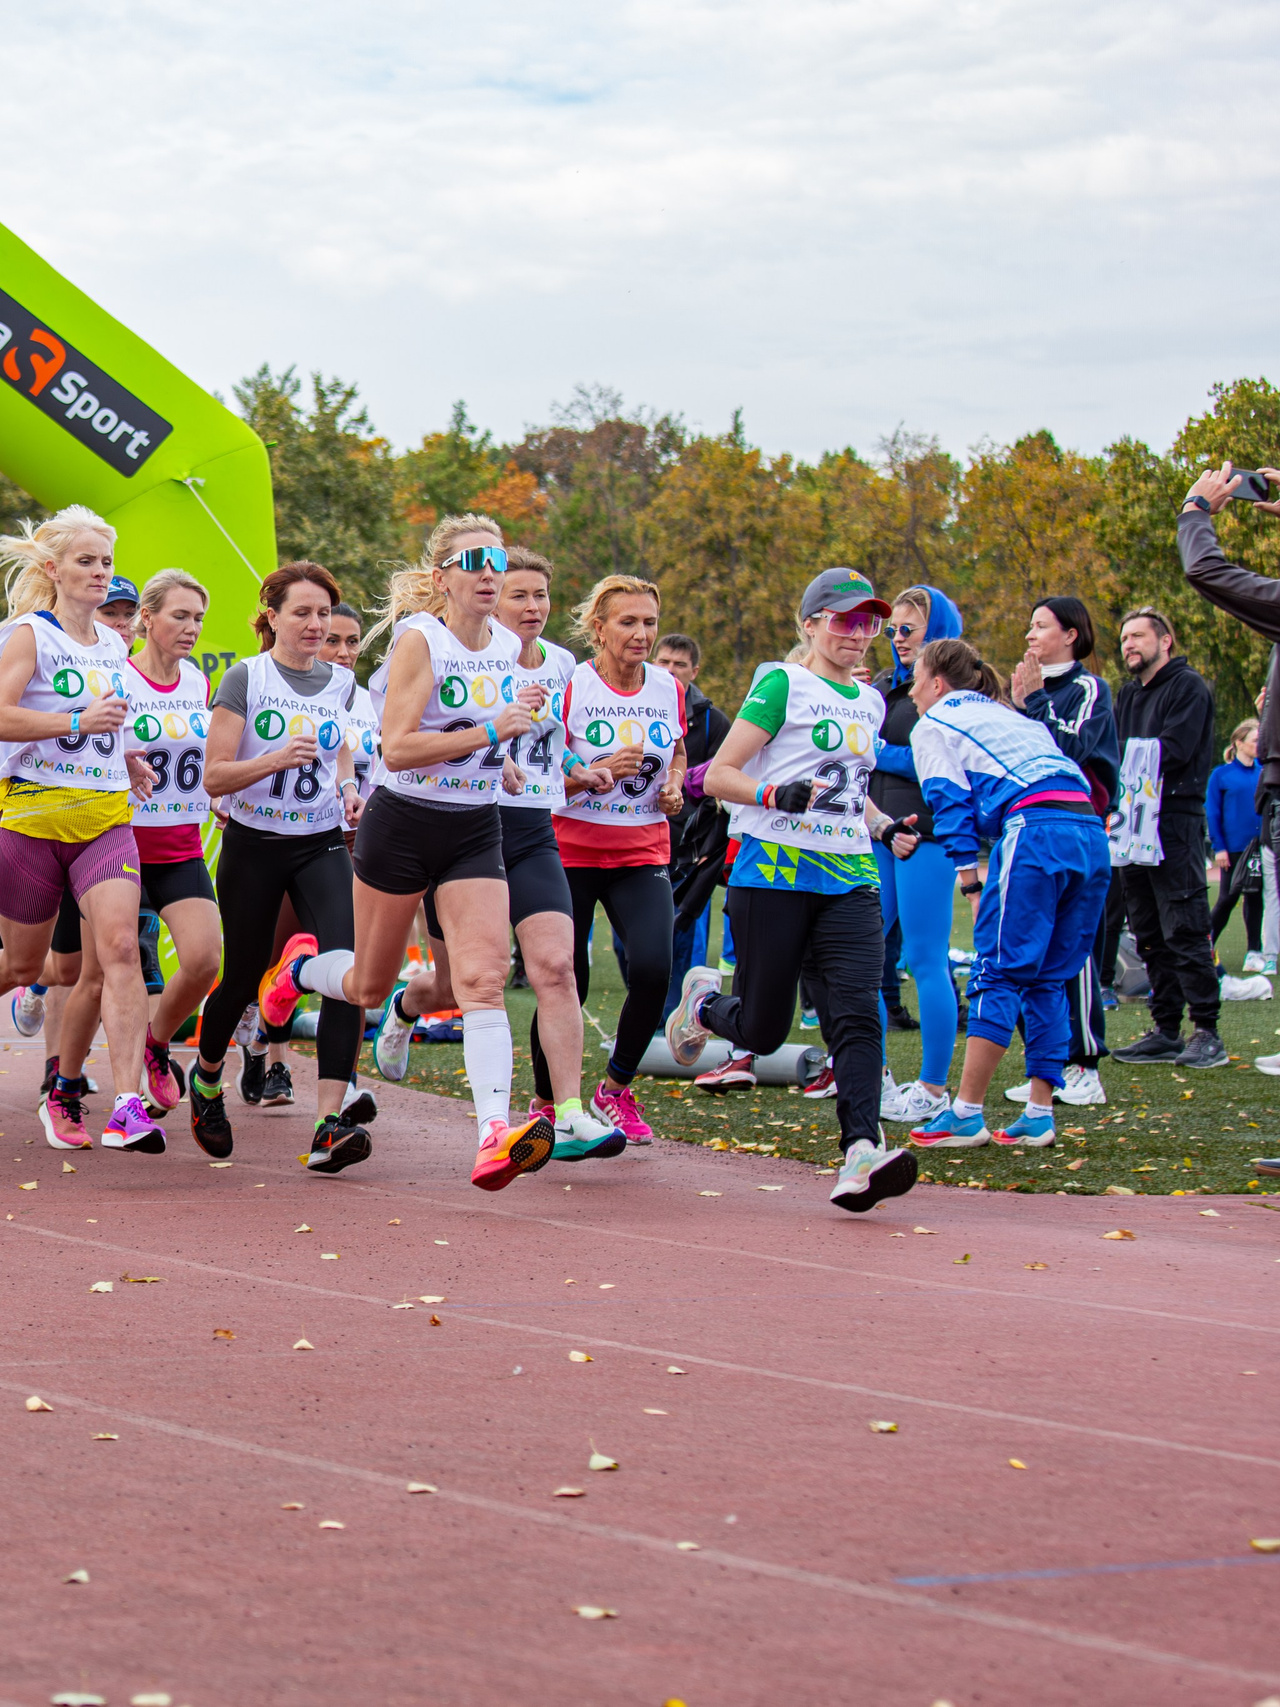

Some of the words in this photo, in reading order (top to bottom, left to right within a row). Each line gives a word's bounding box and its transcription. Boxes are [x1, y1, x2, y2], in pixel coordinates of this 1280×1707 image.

[50, 370, 152, 460] Sport
[130, 700, 204, 713] VMARAFONE
[585, 706, 668, 719] VMARAFONE
[142, 746, 203, 794] 86
[269, 756, 322, 803] 18
[809, 760, 871, 816] 23
